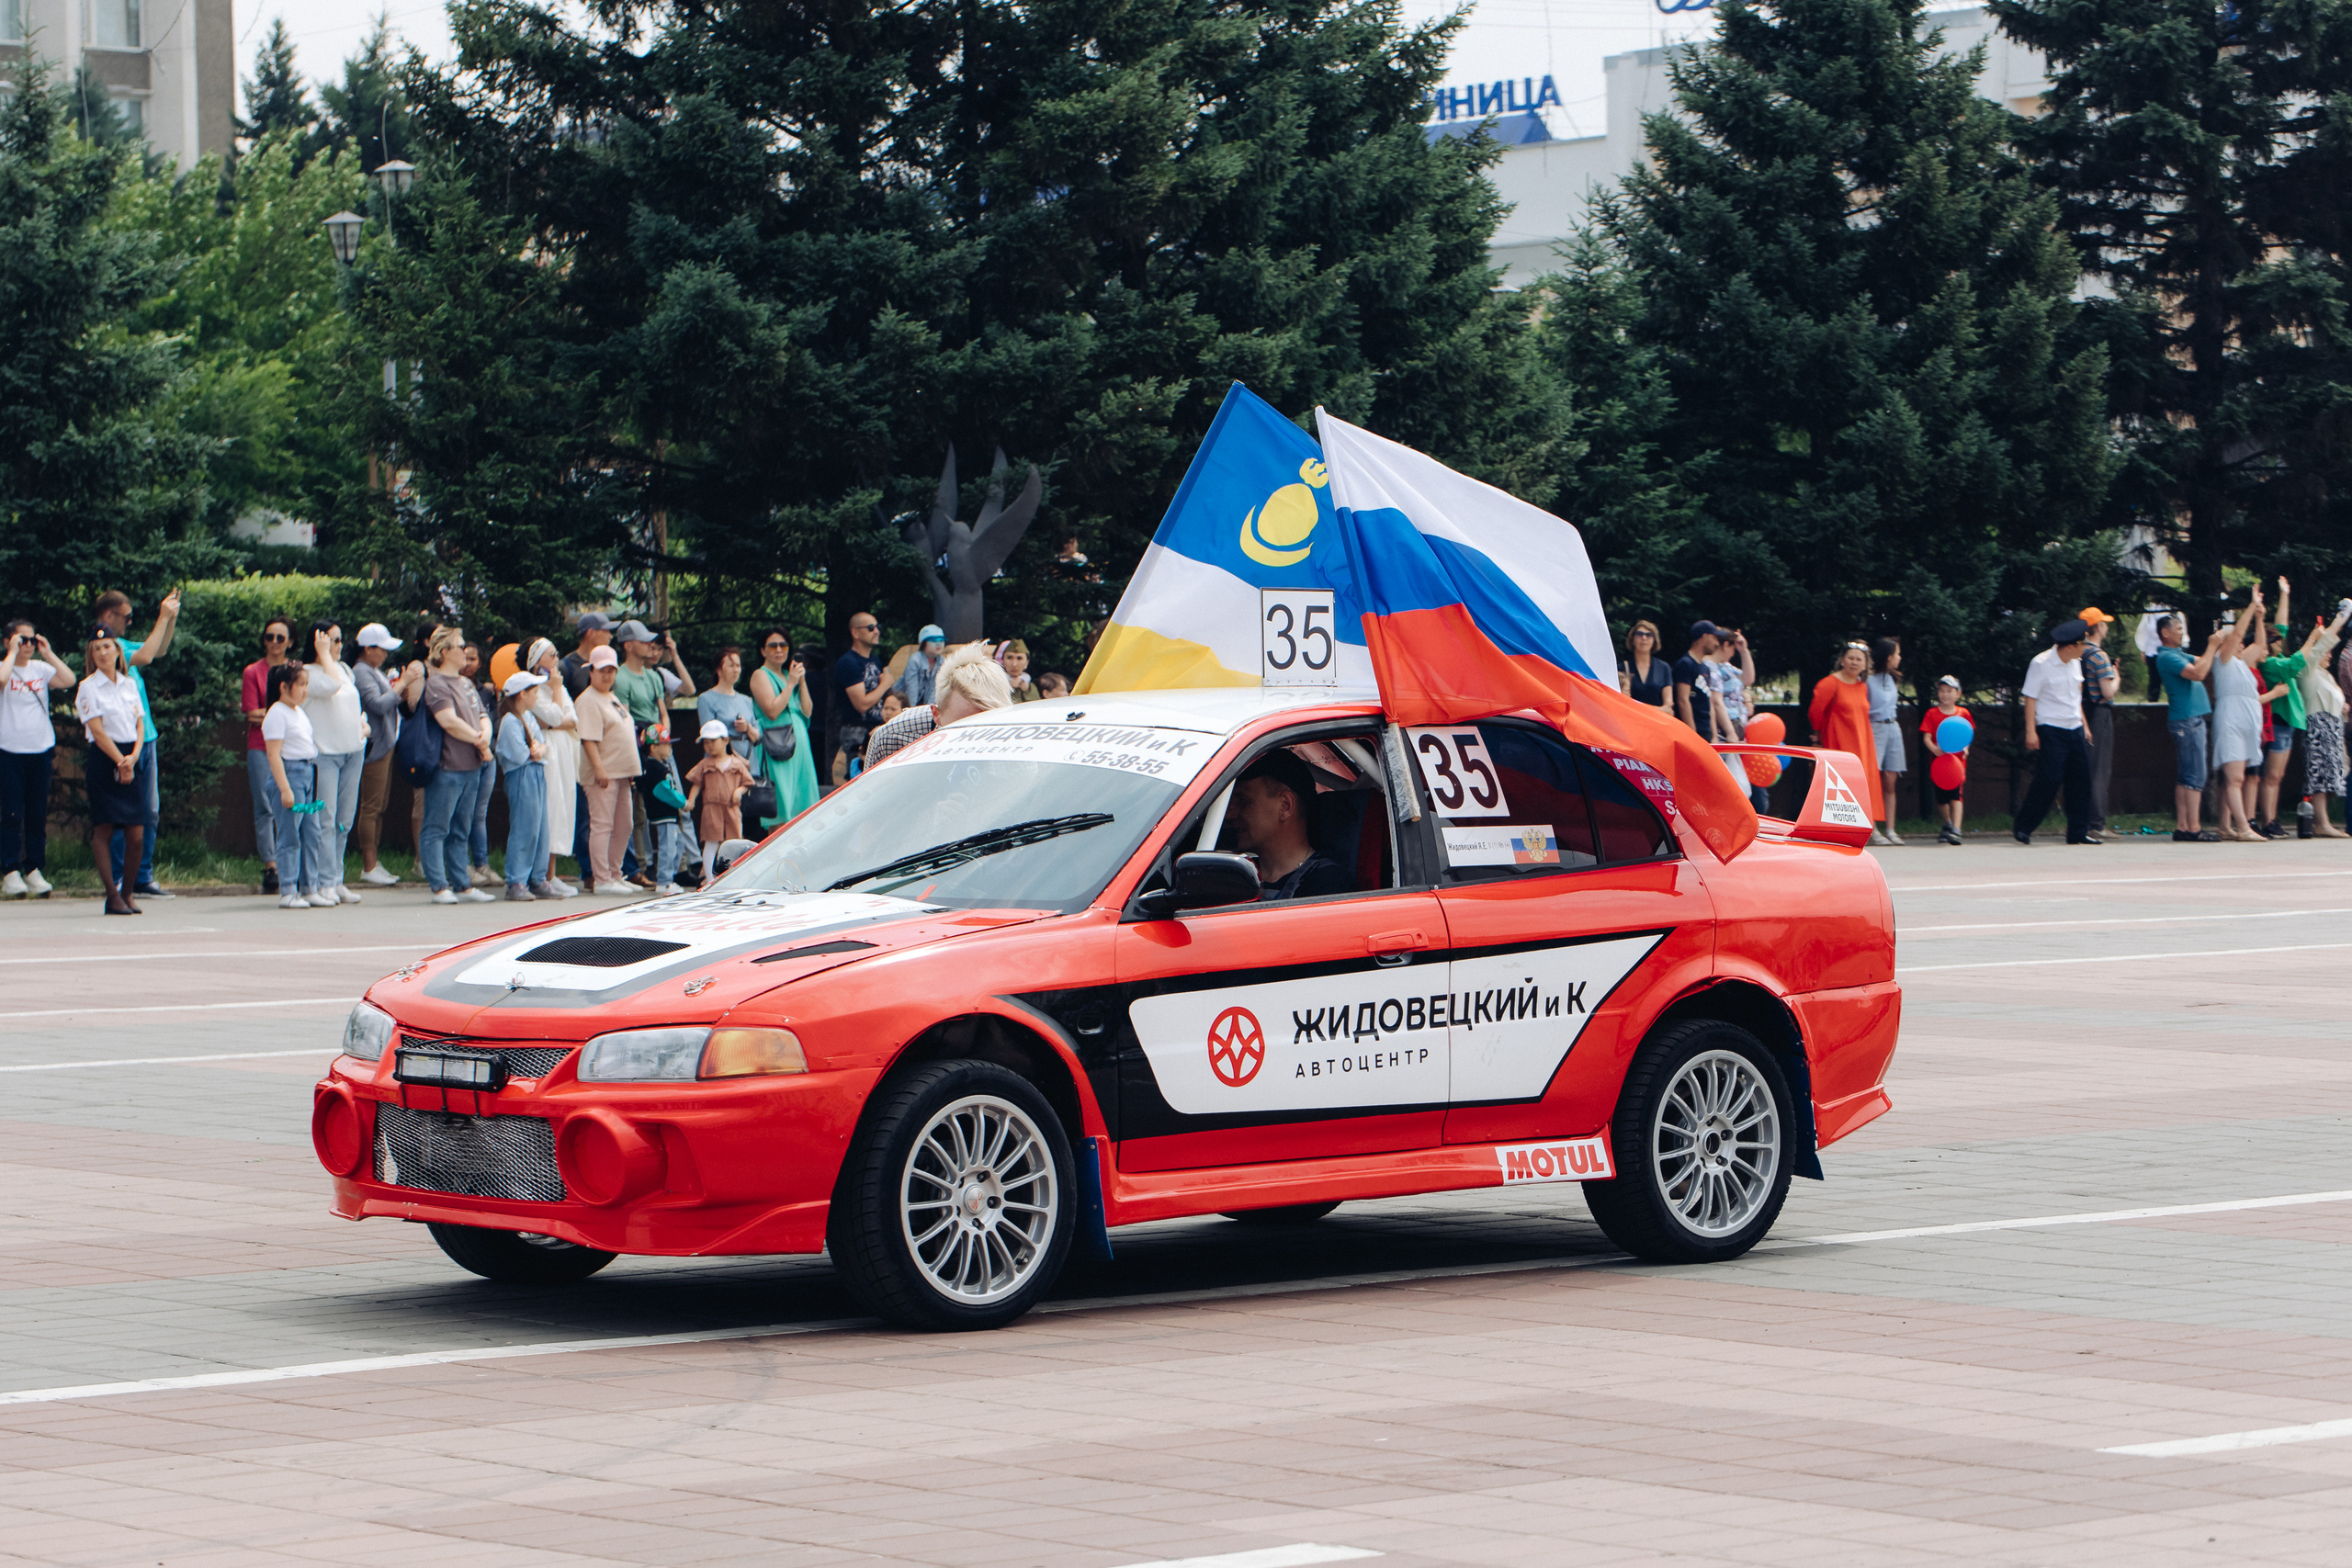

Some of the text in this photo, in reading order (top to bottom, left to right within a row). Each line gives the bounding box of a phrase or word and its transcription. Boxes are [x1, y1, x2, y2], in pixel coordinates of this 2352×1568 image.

[1266, 604, 1332, 671] 35
[933, 746, 1035, 756] АВТОЦЕНТР
[948, 726, 1156, 748] ЖИДОВЕЦКИЙ
[1166, 739, 1198, 757] К
[1080, 750, 1170, 774] 55-38-55
[1418, 733, 1499, 810] 35
[1612, 758, 1651, 773] PIAA
[1824, 802, 1860, 814] MITSUBISHI
[1832, 813, 1857, 823] MOTORS
[1292, 976, 1587, 1045] ЖИДОВЕЦКИЙ и К
[1295, 1048, 1430, 1079] АВТОЦЕНТР
[1506, 1145, 1605, 1180] MOTUL
